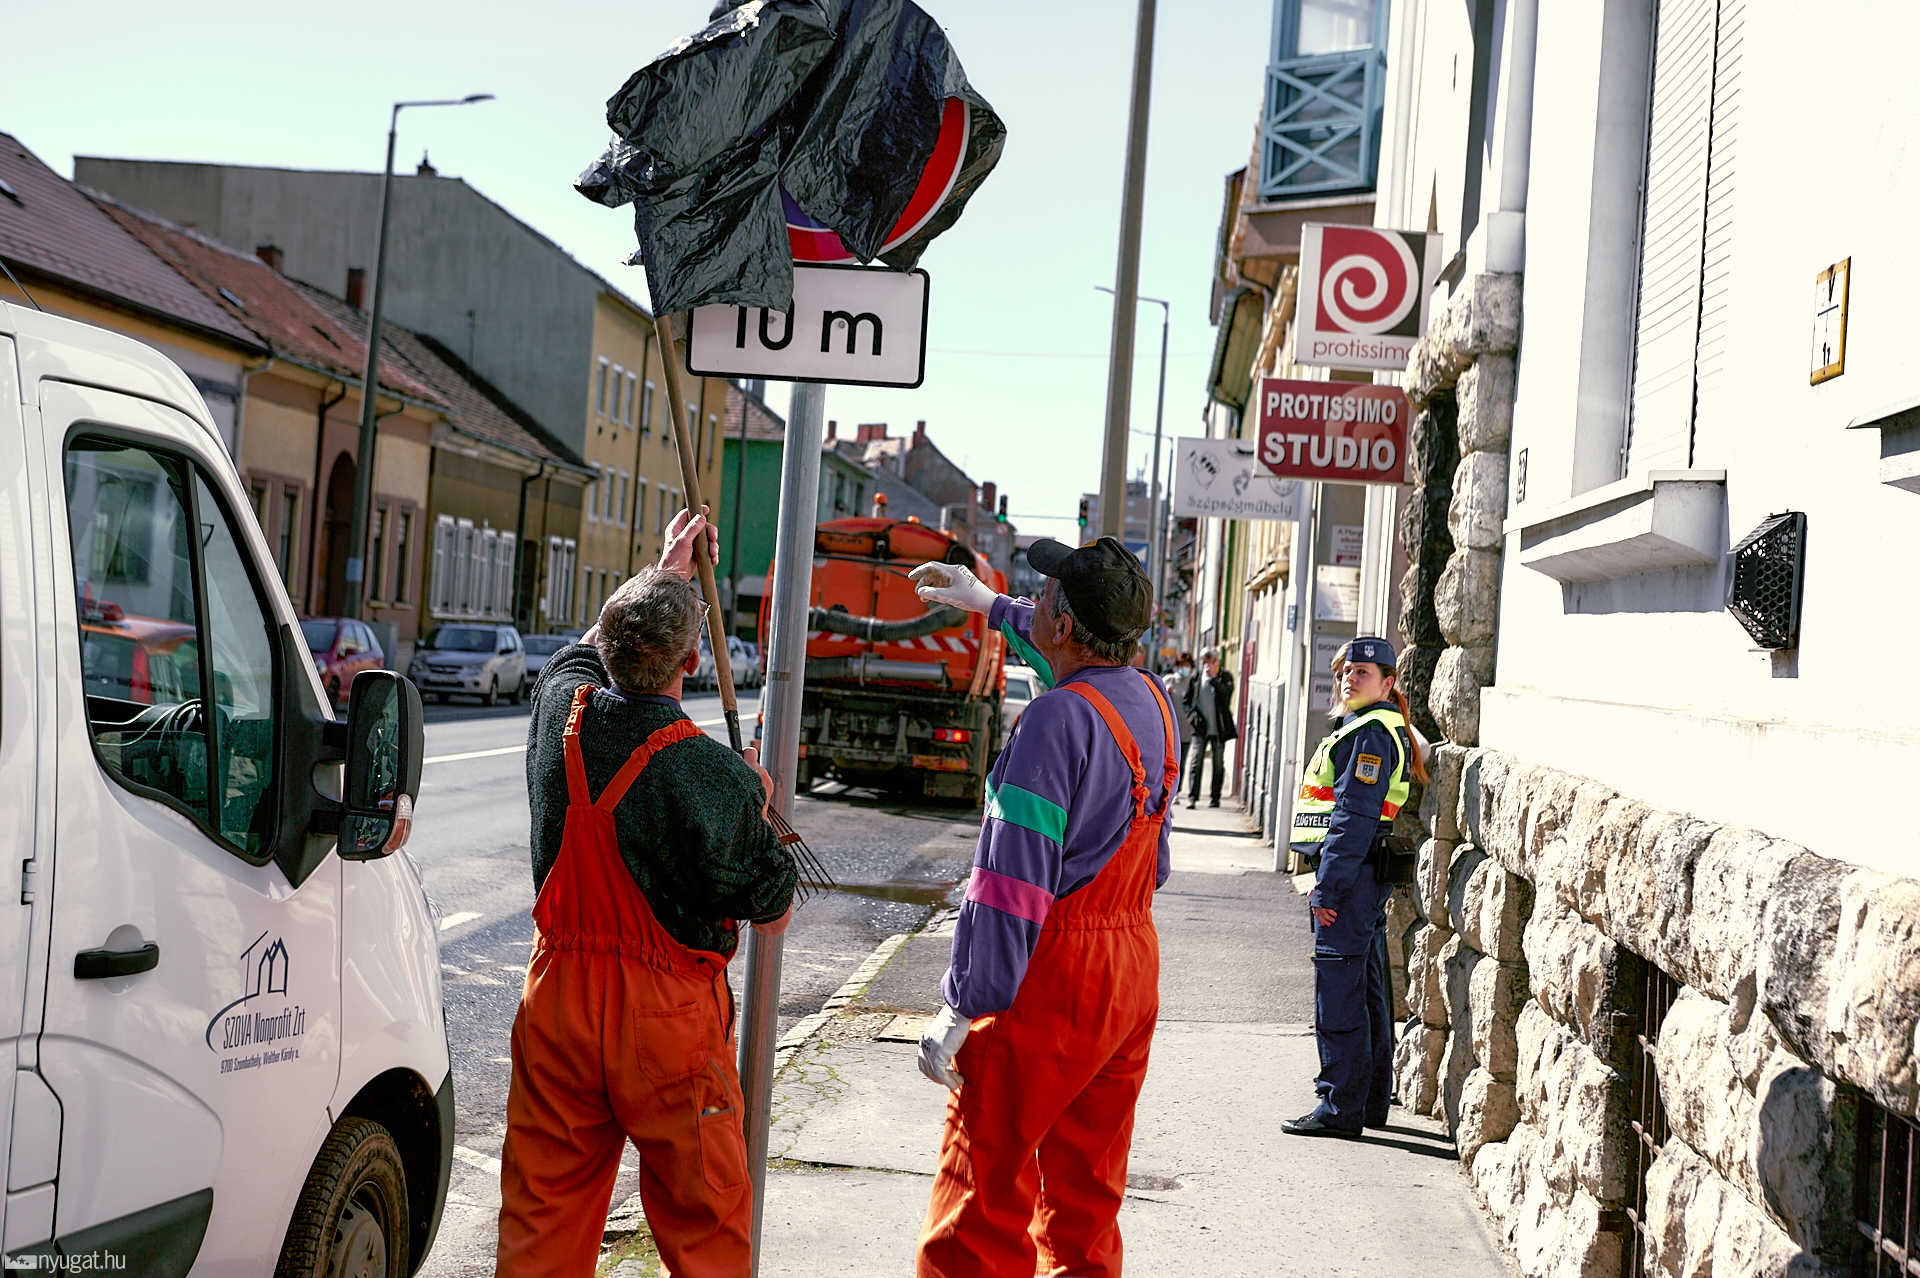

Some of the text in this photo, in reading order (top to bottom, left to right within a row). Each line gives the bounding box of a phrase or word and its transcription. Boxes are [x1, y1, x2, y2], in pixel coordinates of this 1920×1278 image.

[735, 297, 883, 356] 10 m
[1266, 391, 1398, 425] PROTISSIMO
[1263, 432, 1397, 472] STUDIO
[223, 1005, 306, 1049] SZOVA Nonprofit Zrt
